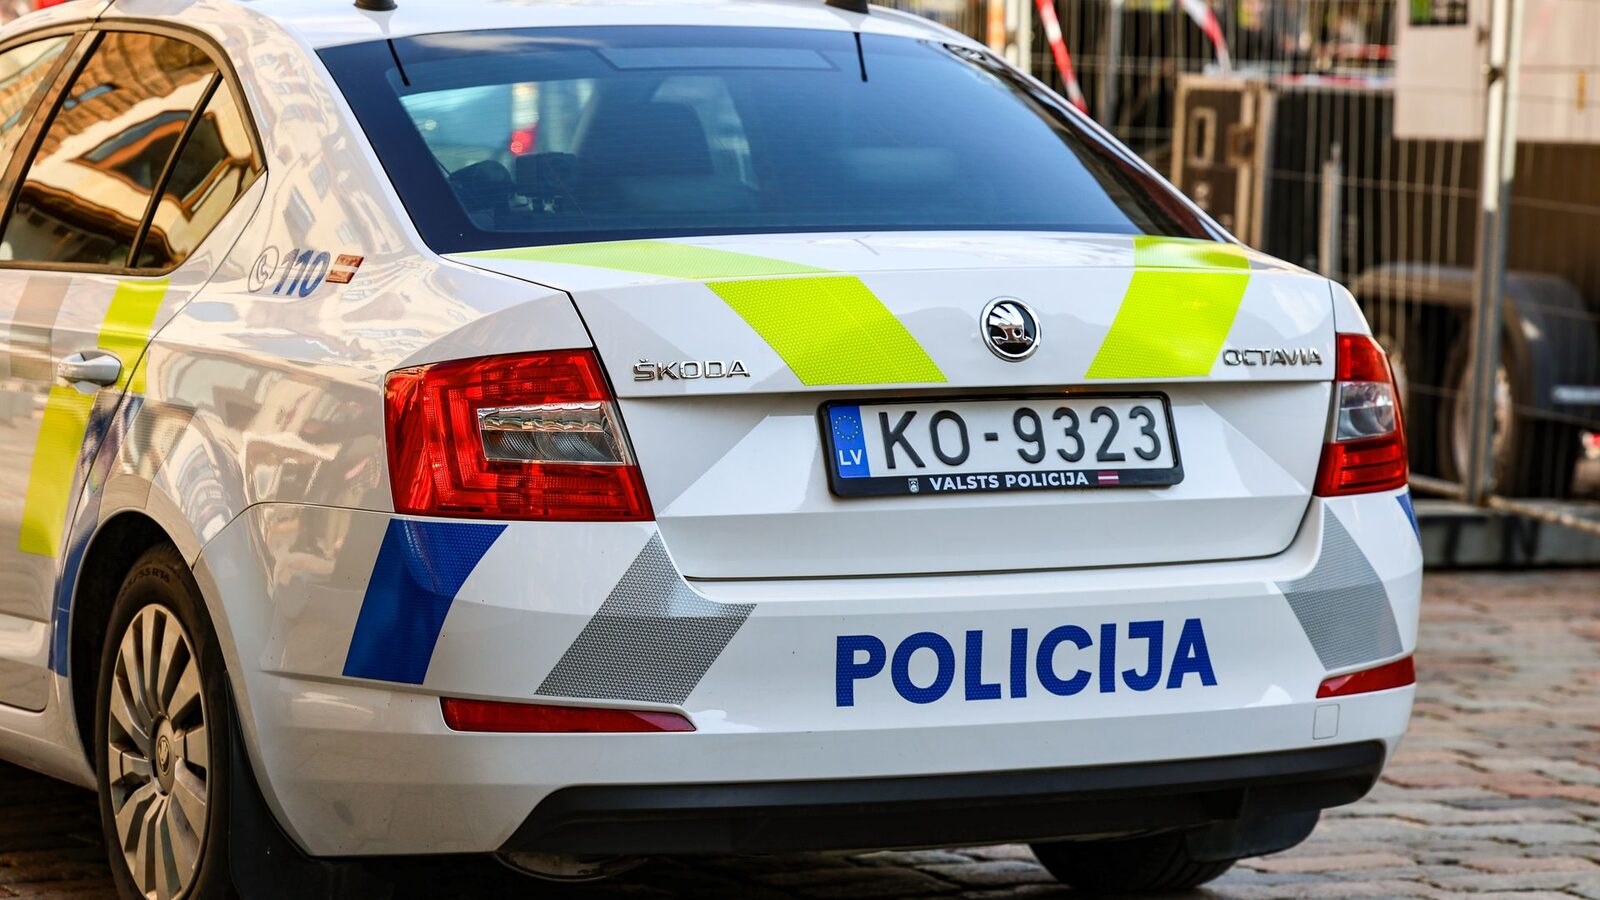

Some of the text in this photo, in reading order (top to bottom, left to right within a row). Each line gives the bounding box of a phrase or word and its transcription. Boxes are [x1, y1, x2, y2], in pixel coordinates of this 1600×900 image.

[273, 248, 331, 298] 110
[1222, 349, 1323, 366] OCTAVIA
[633, 358, 750, 382] ŠKODA
[878, 405, 1162, 469] KO-9323
[838, 449, 862, 466] LV
[929, 470, 1089, 492] VALSTS POLICIJA
[835, 618, 1218, 708] POLICIJA
